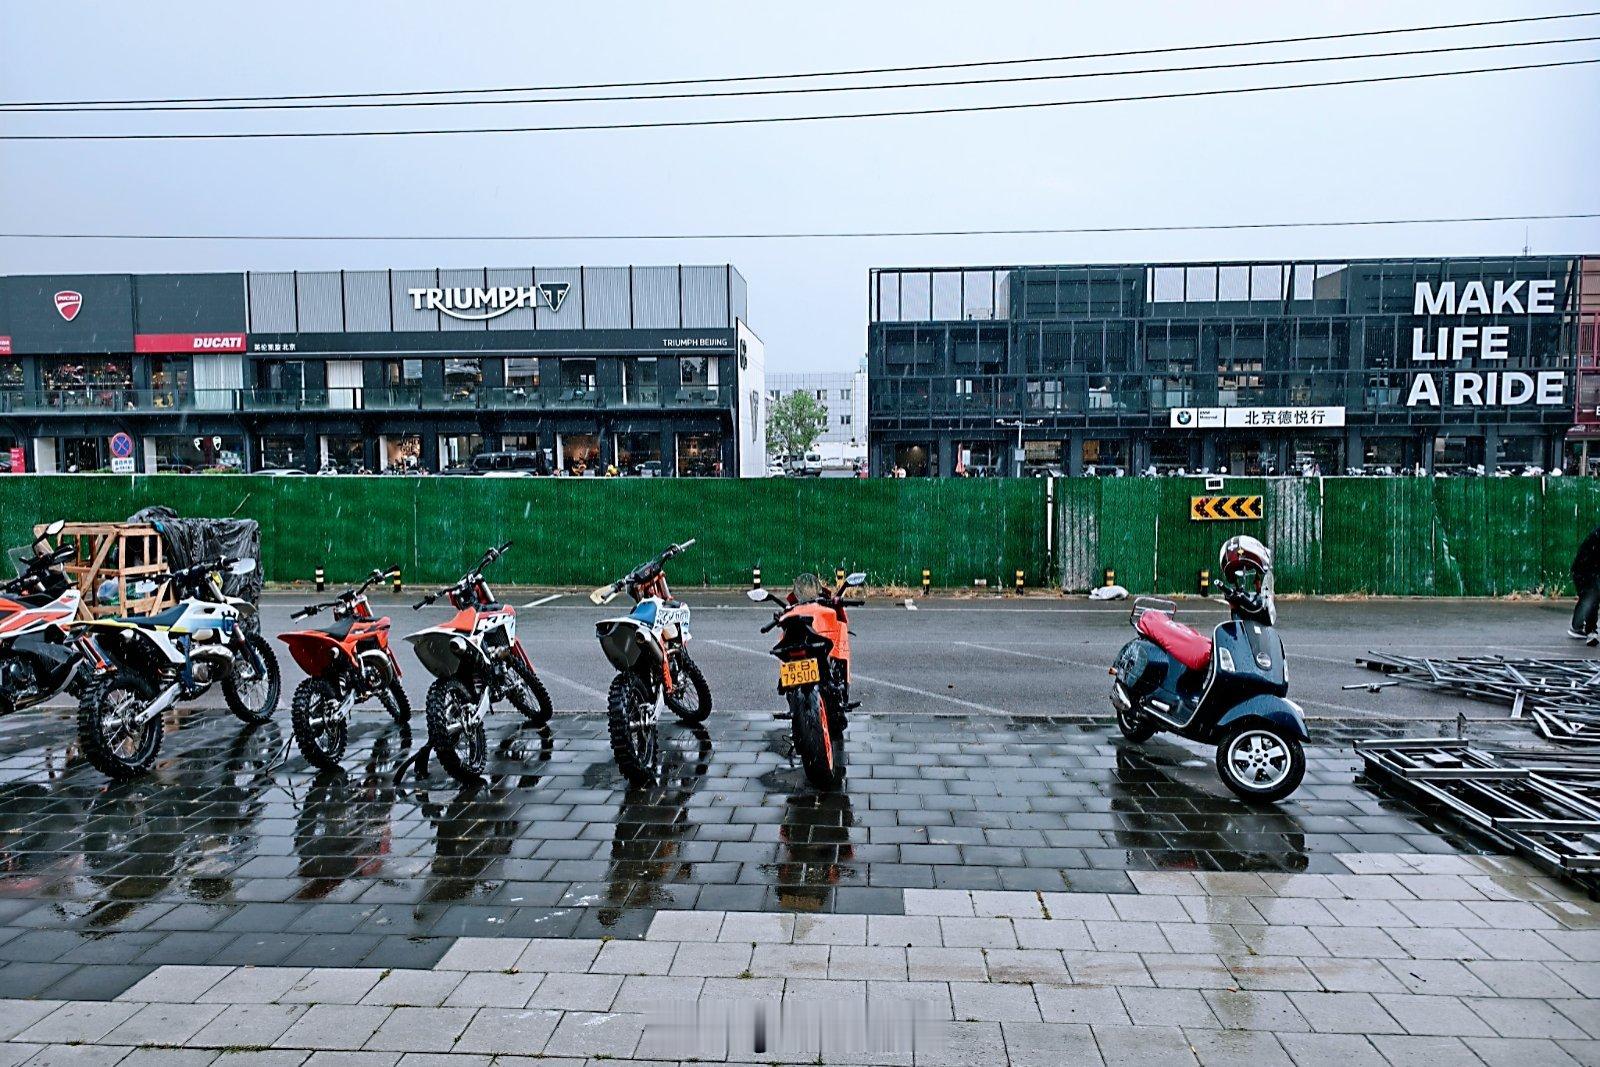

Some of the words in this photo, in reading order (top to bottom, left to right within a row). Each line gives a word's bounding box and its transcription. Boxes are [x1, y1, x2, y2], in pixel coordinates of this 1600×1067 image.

[408, 286, 537, 320] TRIUMPH
[1413, 280, 1556, 315] MAKE
[193, 337, 242, 348] DUCATI
[1412, 326, 1510, 360] LIFE
[1406, 373, 1440, 406] A
[1453, 371, 1565, 405] RIDE
[1245, 410, 1325, 425] 北京德悦行
